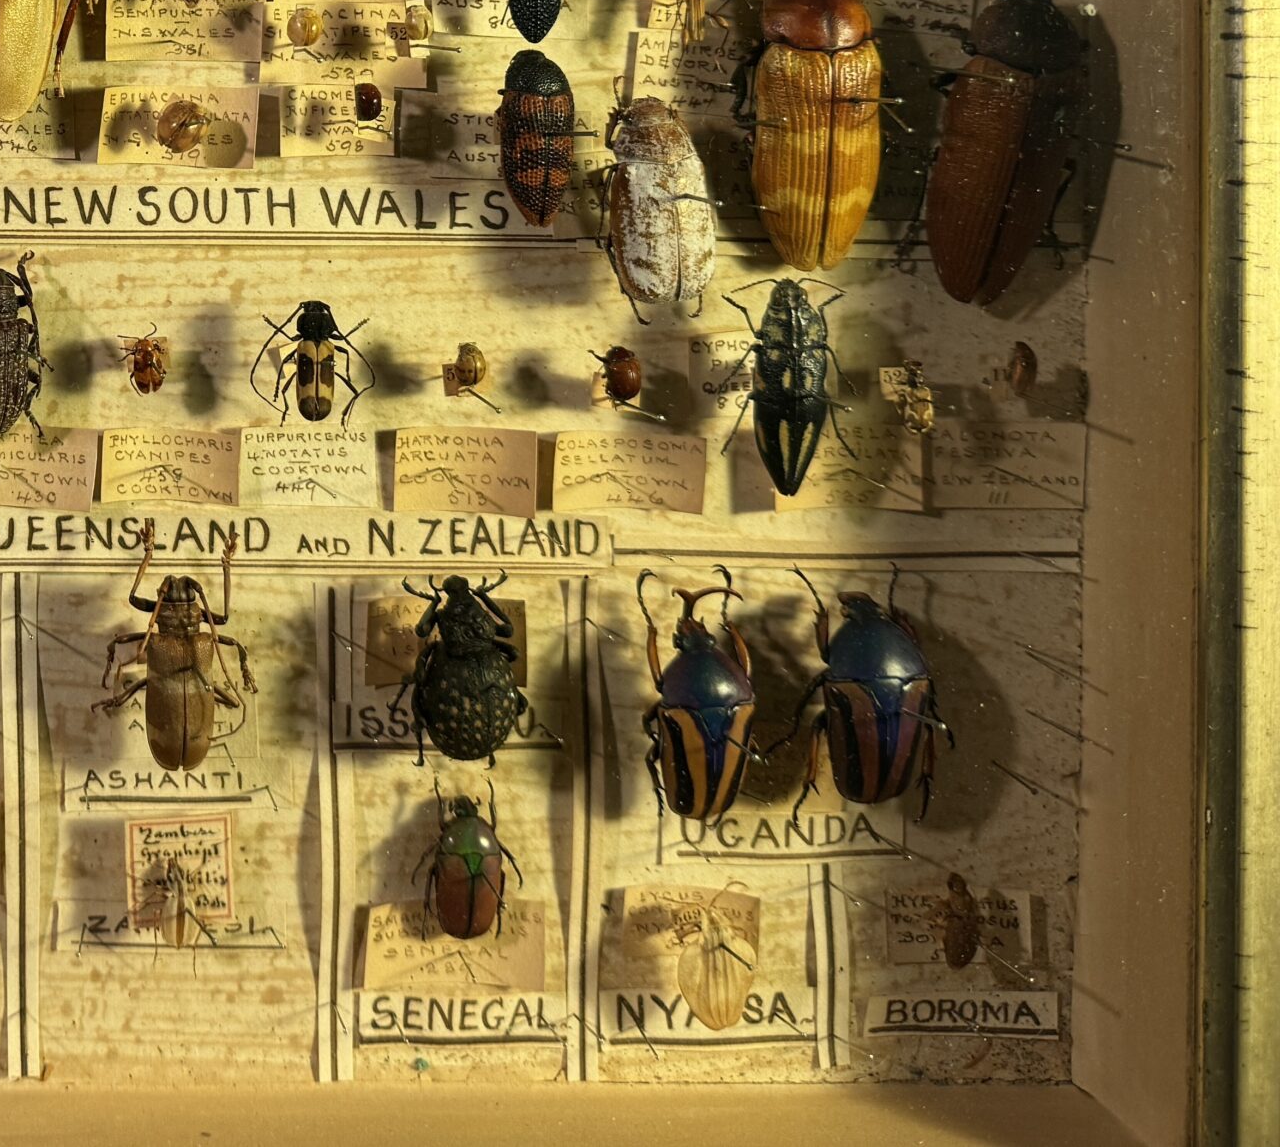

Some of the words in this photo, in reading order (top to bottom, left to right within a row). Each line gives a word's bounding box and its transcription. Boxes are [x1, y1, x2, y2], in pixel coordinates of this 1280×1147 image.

[113, 6, 251, 18] SEMIPUNCTATA
[3, 185, 114, 226] NEW
[135, 185, 296, 227] SOUTH
[319, 185, 510, 229] WALES
[110, 434, 233, 451] PHYLLOCHARIS
[244, 432, 367, 444] PURPURICENUS
[397, 435, 503, 448] HARMONIA
[115, 450, 211, 463] CYANIPES
[396, 451, 496, 463] ARCUATA
[253, 464, 367, 475] COOKTOWN
[399, 472, 529, 489] COOKTOWN
[562, 473, 688, 488] COOKTOWN
[936, 473, 972, 486] NEW
[983, 473, 1078, 486] ZEALAND
[116, 485, 234, 502] COOKTOWN
[297, 533, 350, 556] AND
[420, 519, 599, 556] ZEALAND
[679, 813, 875, 847] UGANDA
[886, 1000, 1040, 1025] BOROMA
